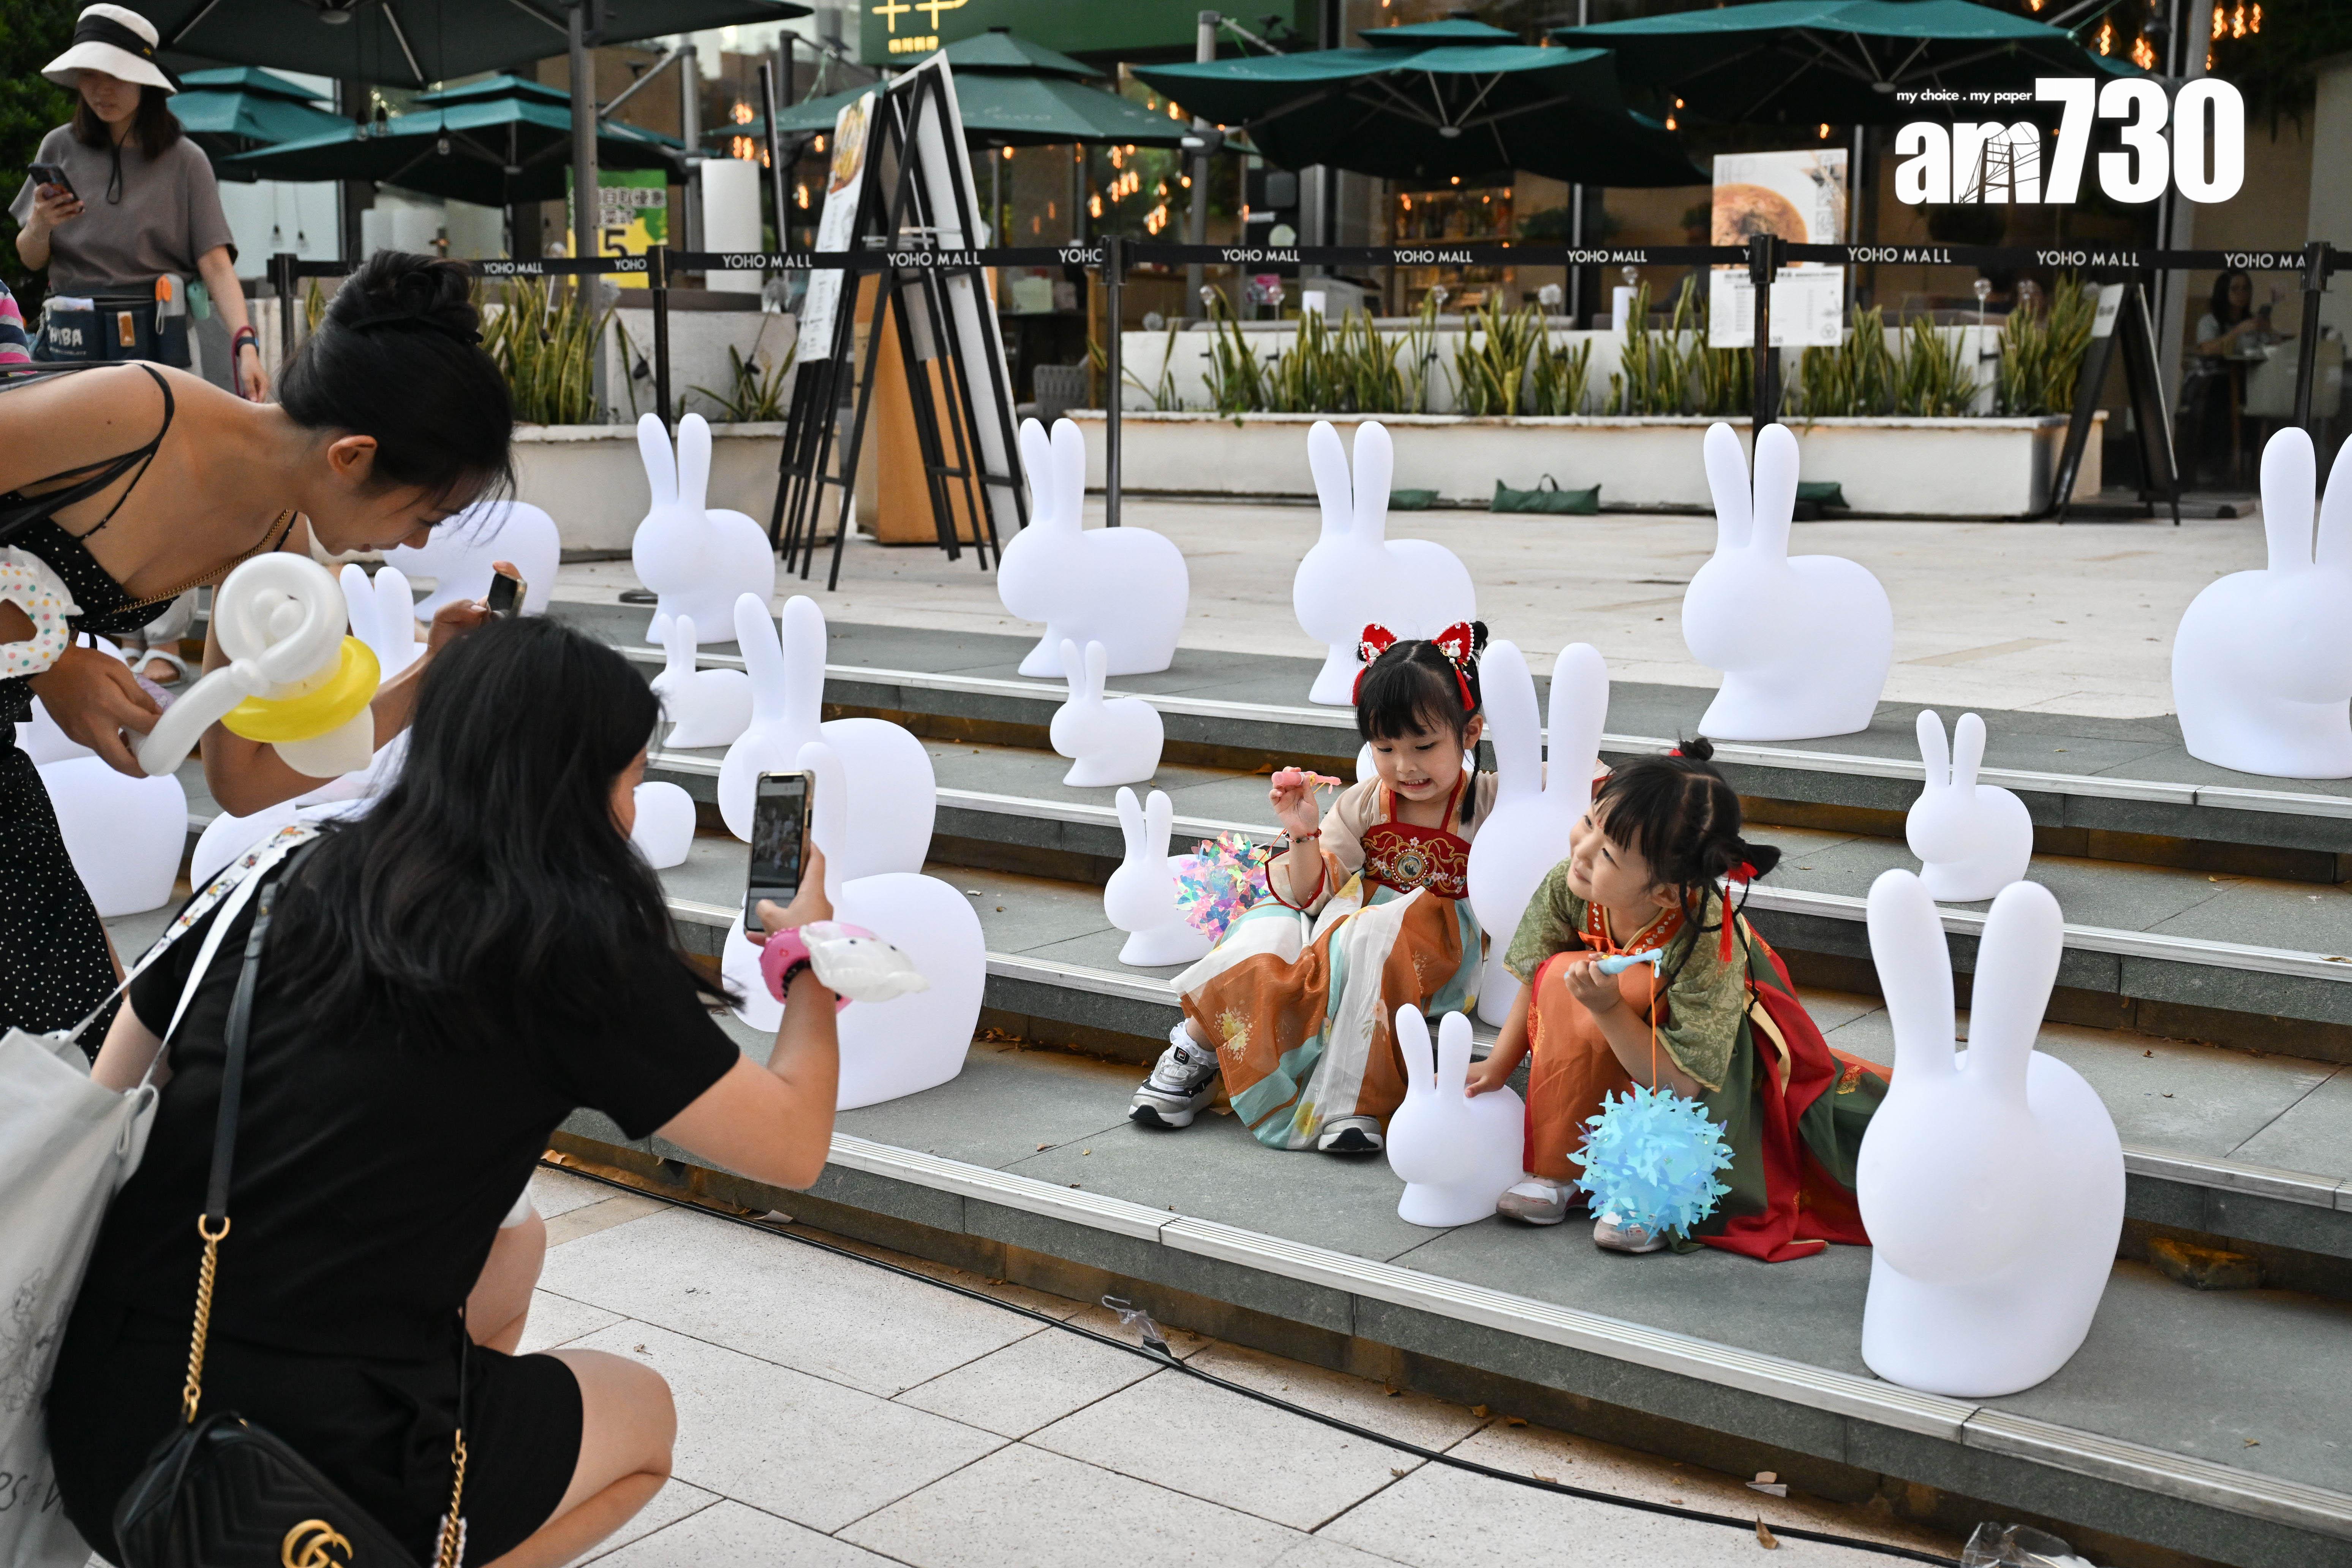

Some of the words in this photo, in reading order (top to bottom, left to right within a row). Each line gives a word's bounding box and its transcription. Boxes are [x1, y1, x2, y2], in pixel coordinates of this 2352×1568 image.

[723, 255, 766, 268] YOHO
[771, 254, 812, 268] MALL
[887, 252, 933, 267] YOHO
[937, 251, 981, 266] MALL
[1222, 249, 1262, 261] YOHO
[1266, 250, 1300, 262] MALL
[1394, 250, 1435, 263] YOHO
[1438, 251, 1473, 263] MALL
[1567, 250, 1609, 263] YOHO
[1612, 250, 1647, 262] MALL
[1848, 247, 1898, 262] YOHO
[1903, 248, 1951, 263] MALL
[2037, 251, 2086, 266] YOHO
[2092, 252, 2139, 267] MALL
[2225, 253, 2274, 268] YOHO
[2279, 255, 2305, 268] MA
[484, 262, 515, 274] YOHO
[517, 262, 543, 273] MALL
[615, 259, 647, 271] YOHO
